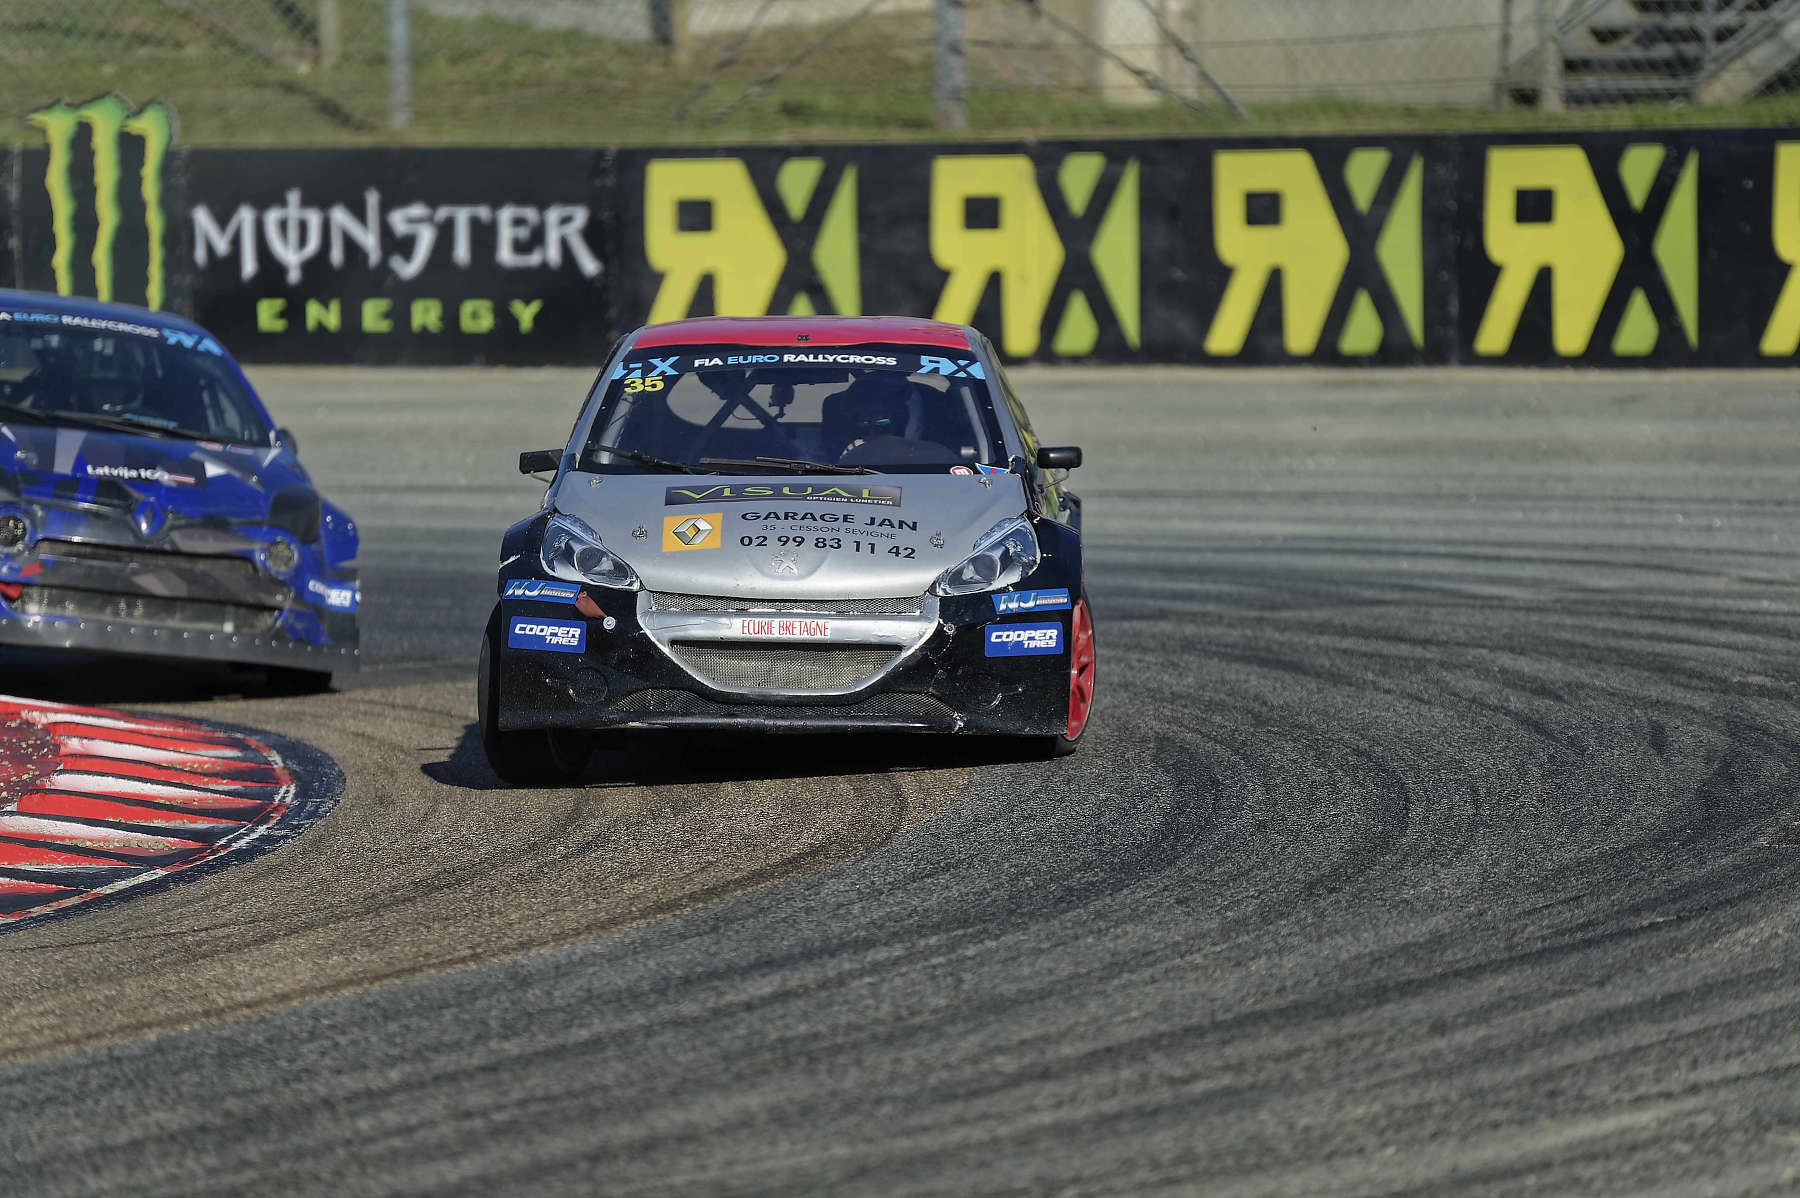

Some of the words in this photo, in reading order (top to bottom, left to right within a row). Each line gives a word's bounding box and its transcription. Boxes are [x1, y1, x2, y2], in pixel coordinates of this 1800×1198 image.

[193, 187, 603, 285] MONSTER
[928, 151, 1142, 357] RX
[1203, 146, 1425, 357] RX
[1472, 142, 1699, 357] RX
[13, 312, 59, 324] EURO
[61, 314, 160, 338] RALLYCROSS
[256, 298, 544, 333] ENERGY
[694, 359, 724, 368] FIA
[727, 354, 780, 365] EURO
[783, 353, 898, 366] RALLYCROSS
[916, 355, 987, 380] RX
[624, 376, 665, 393] 35
[671, 485, 893, 499] VISUAL
[741, 511, 855, 524] GARAGE
[864, 516, 918, 531] JAN
[790, 524, 840, 533] CESSON
[844, 527, 897, 540] SEVIGNE
[739, 535, 768, 547] 02
[777, 535, 805, 548] 99
[814, 537, 842, 550] 83
[853, 540, 876, 555] 11
[887, 545, 916, 560] 42
[514, 623, 581, 638] COOPER
[741, 619, 776, 636] ECURIE
[778, 619, 830, 637] BRETAGNE
[990, 629, 1058, 643] COOPER
[545, 636, 579, 646] TIRES
[1022, 640, 1057, 649] TIRES
